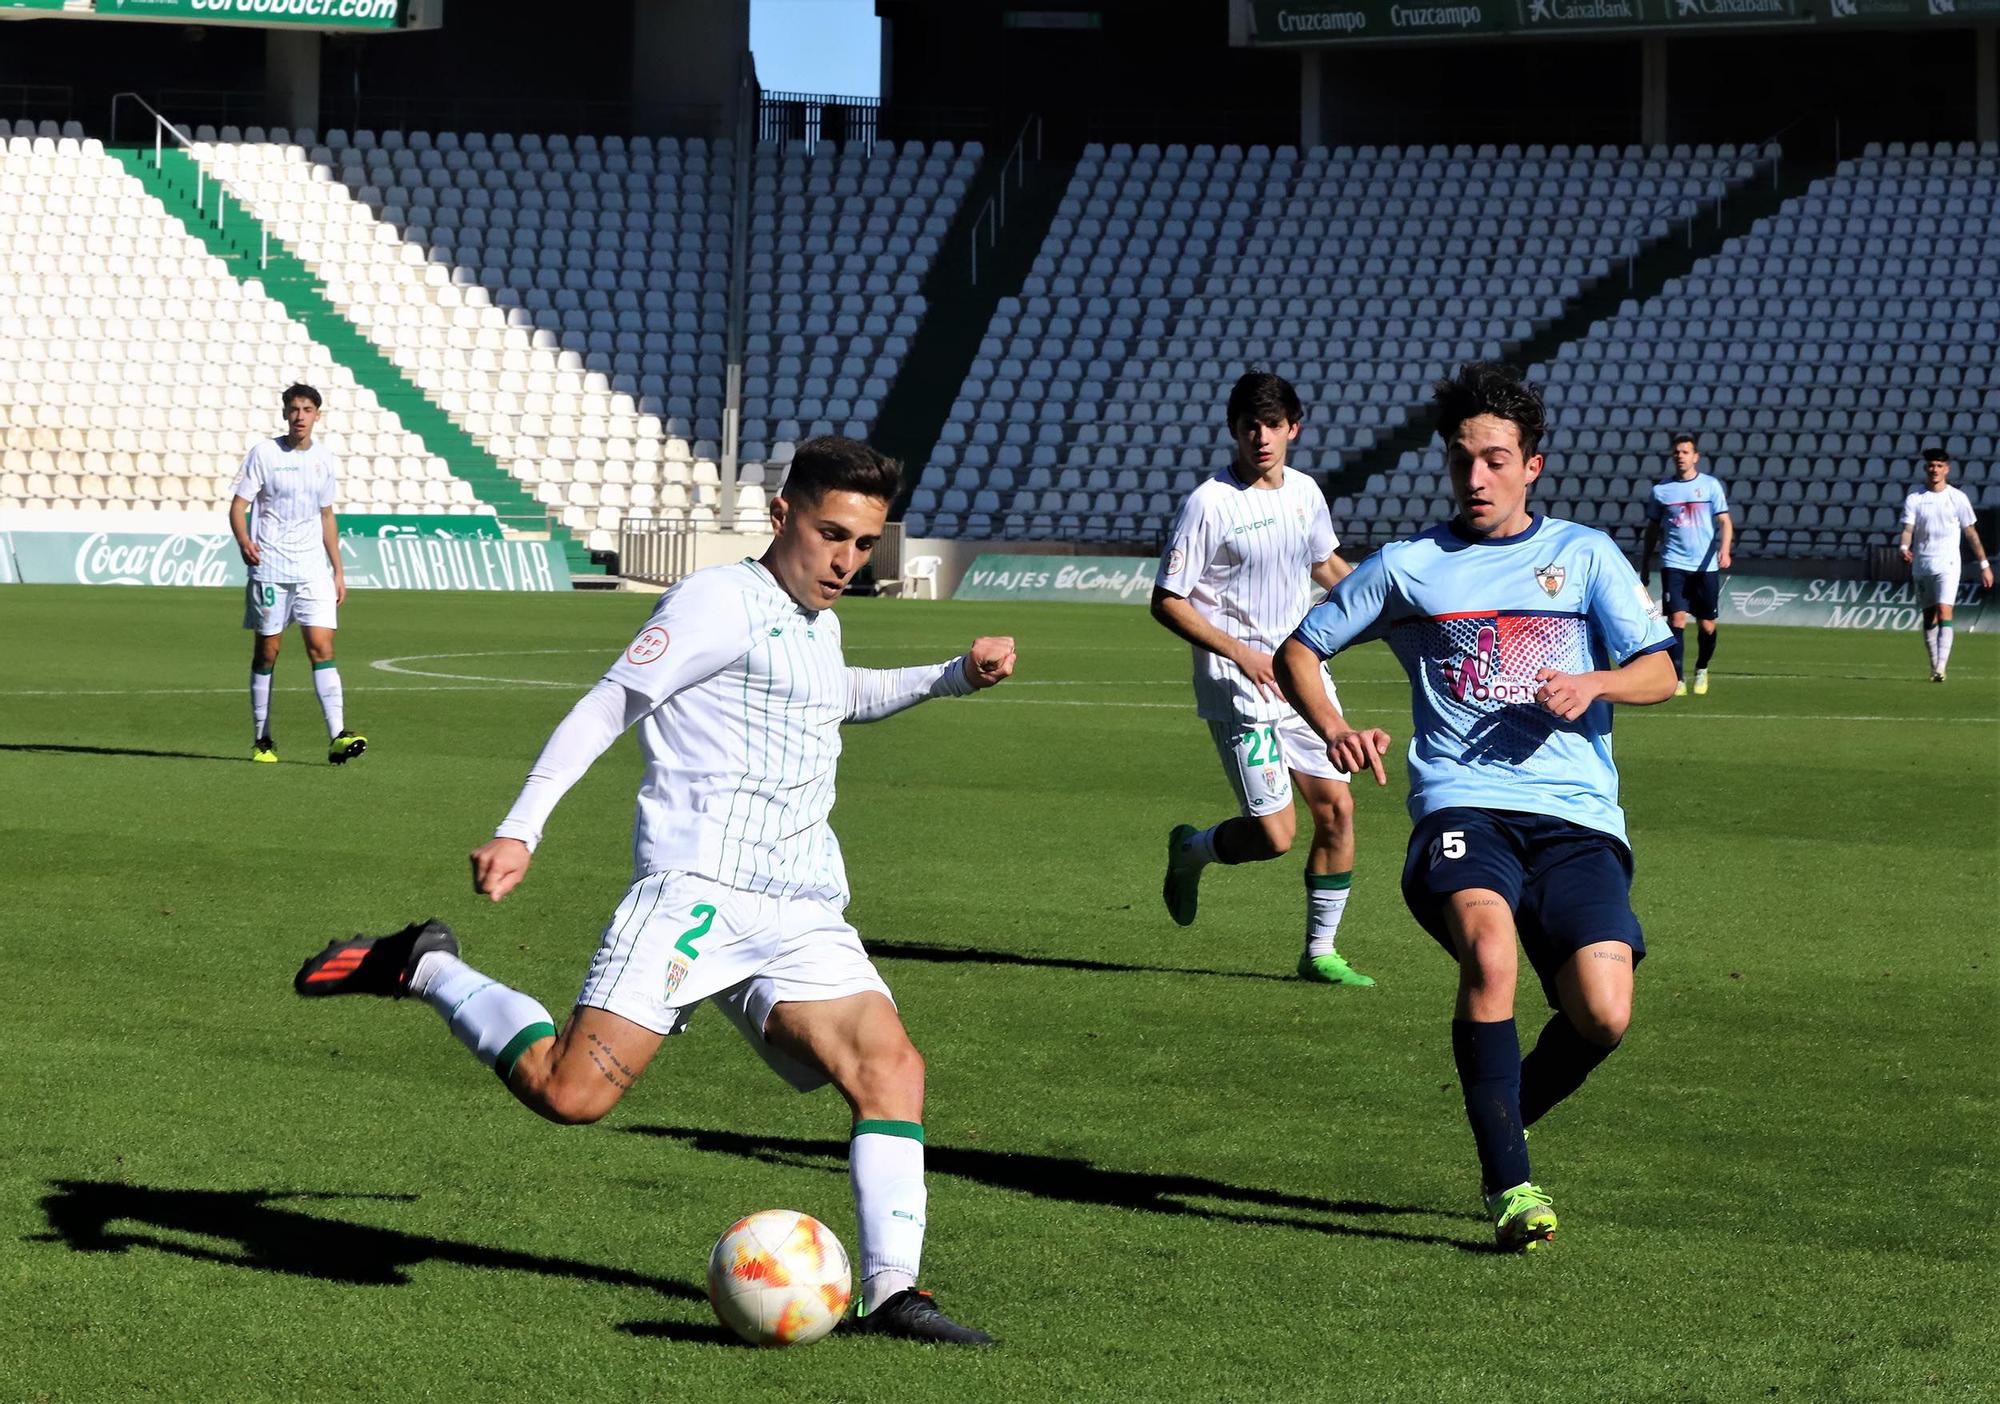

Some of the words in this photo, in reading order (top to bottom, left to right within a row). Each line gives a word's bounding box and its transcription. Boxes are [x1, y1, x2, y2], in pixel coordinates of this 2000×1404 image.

[1278, 10, 1366, 33] Cruzcampo
[1390, 5, 1481, 28] Cruzcampo
[1552, 0, 1633, 20] CaixaBank
[75, 532, 231, 587] Coca-Cola
[378, 539, 554, 592] GINBULEVAR
[972, 571, 1050, 591] VIAJES
[1054, 565, 1079, 589] El
[1076, 566, 1128, 590] Corte
[1803, 579, 1869, 603] SAN
[1243, 727, 1281, 767] 22
[674, 904, 717, 961] 2
